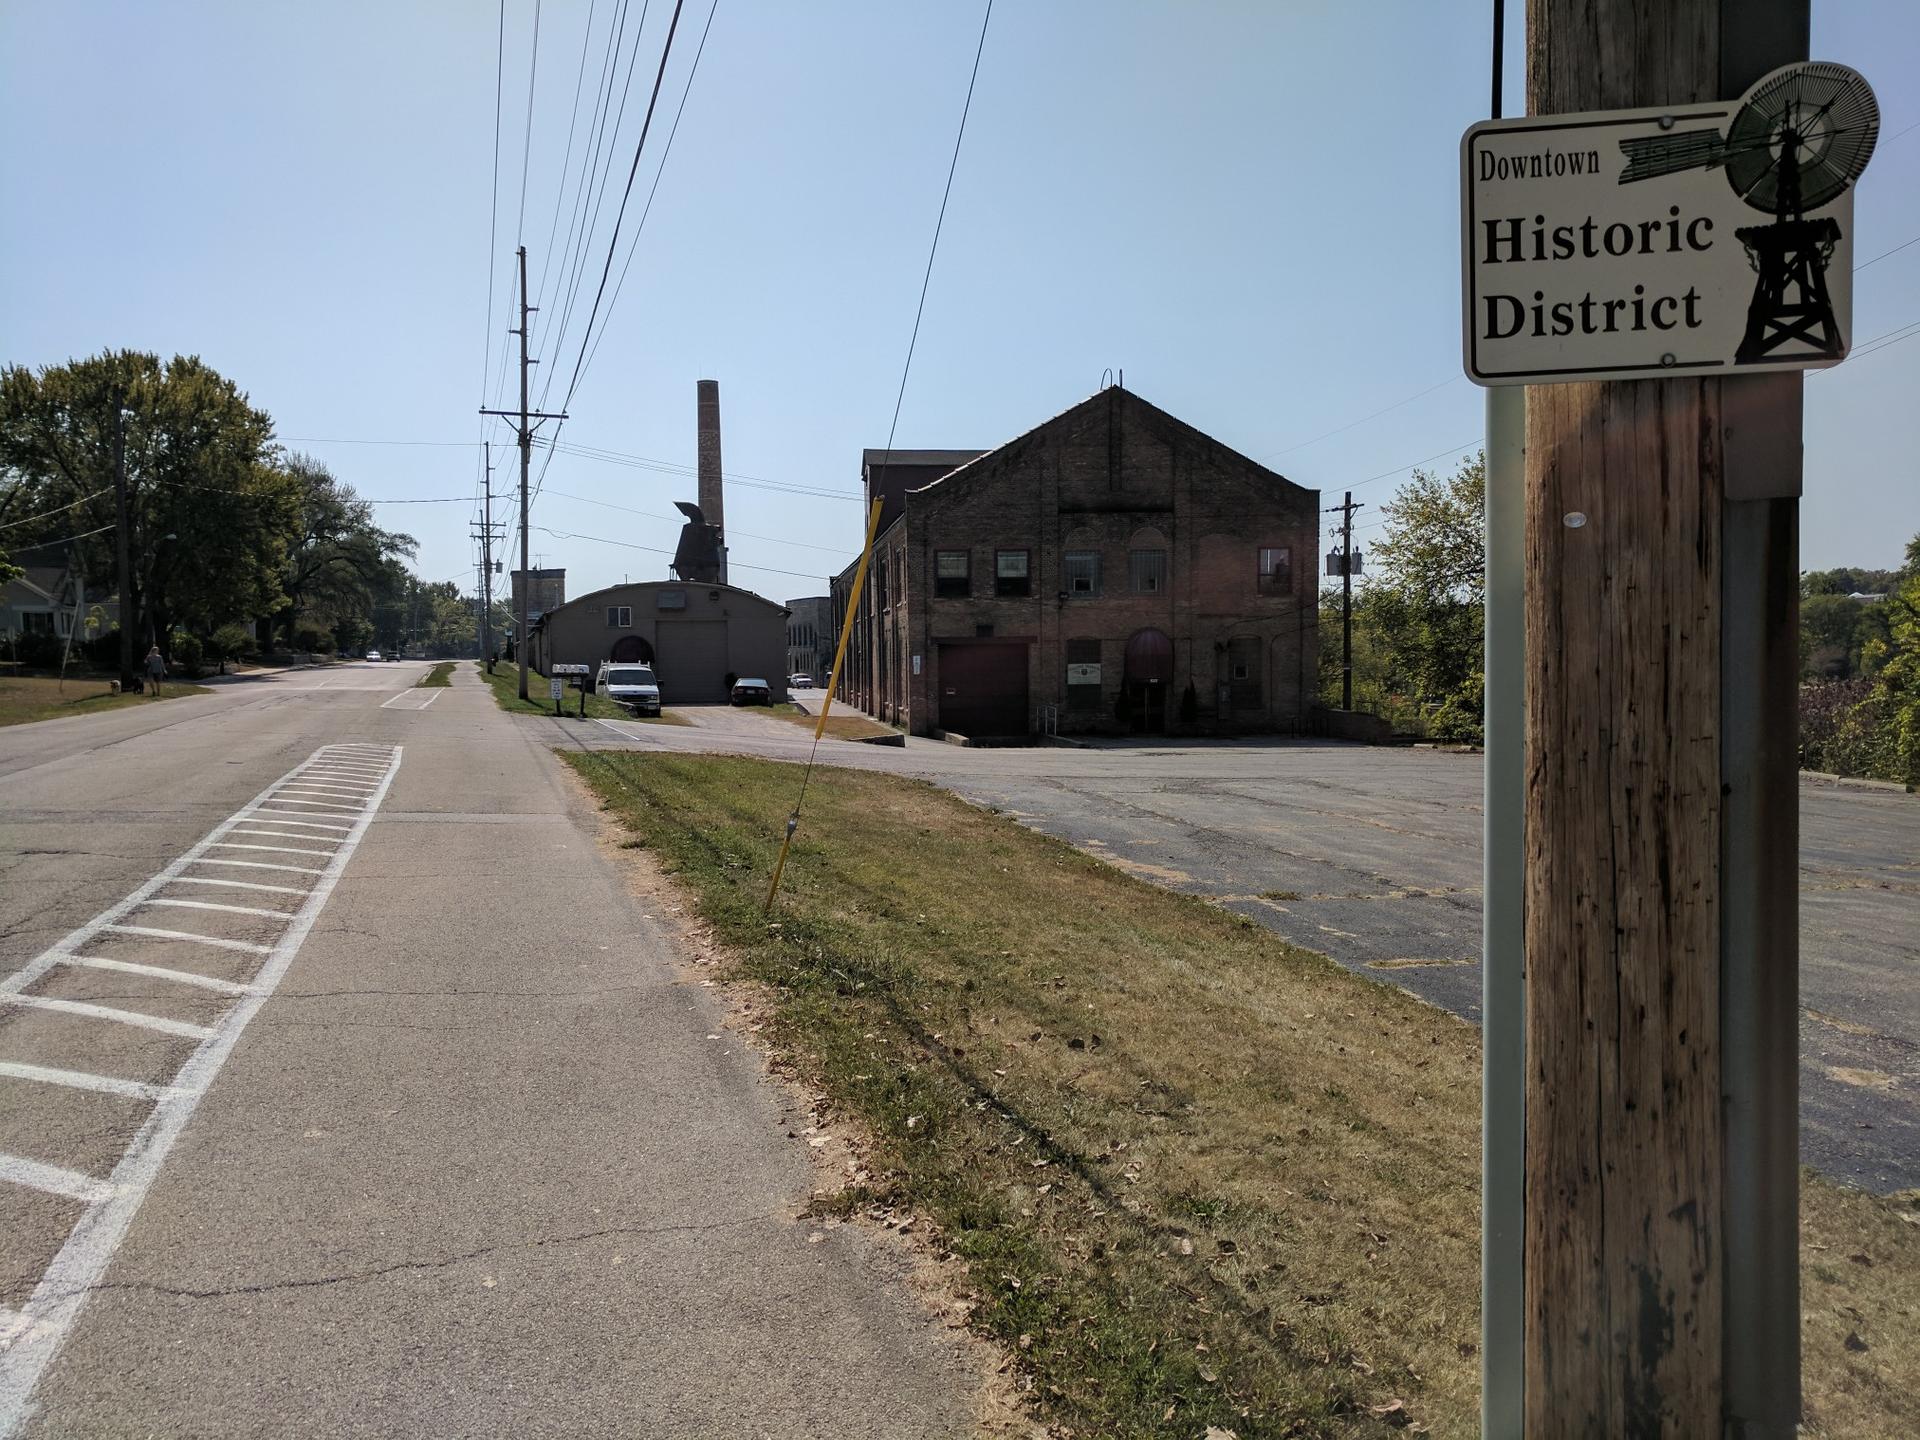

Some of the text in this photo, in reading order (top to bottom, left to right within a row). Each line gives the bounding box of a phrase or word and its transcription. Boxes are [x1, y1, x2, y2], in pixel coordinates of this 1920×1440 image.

[1480, 148, 1600, 182] Downtown
[1482, 205, 1714, 264] Historic
[1483, 284, 1703, 339] District
